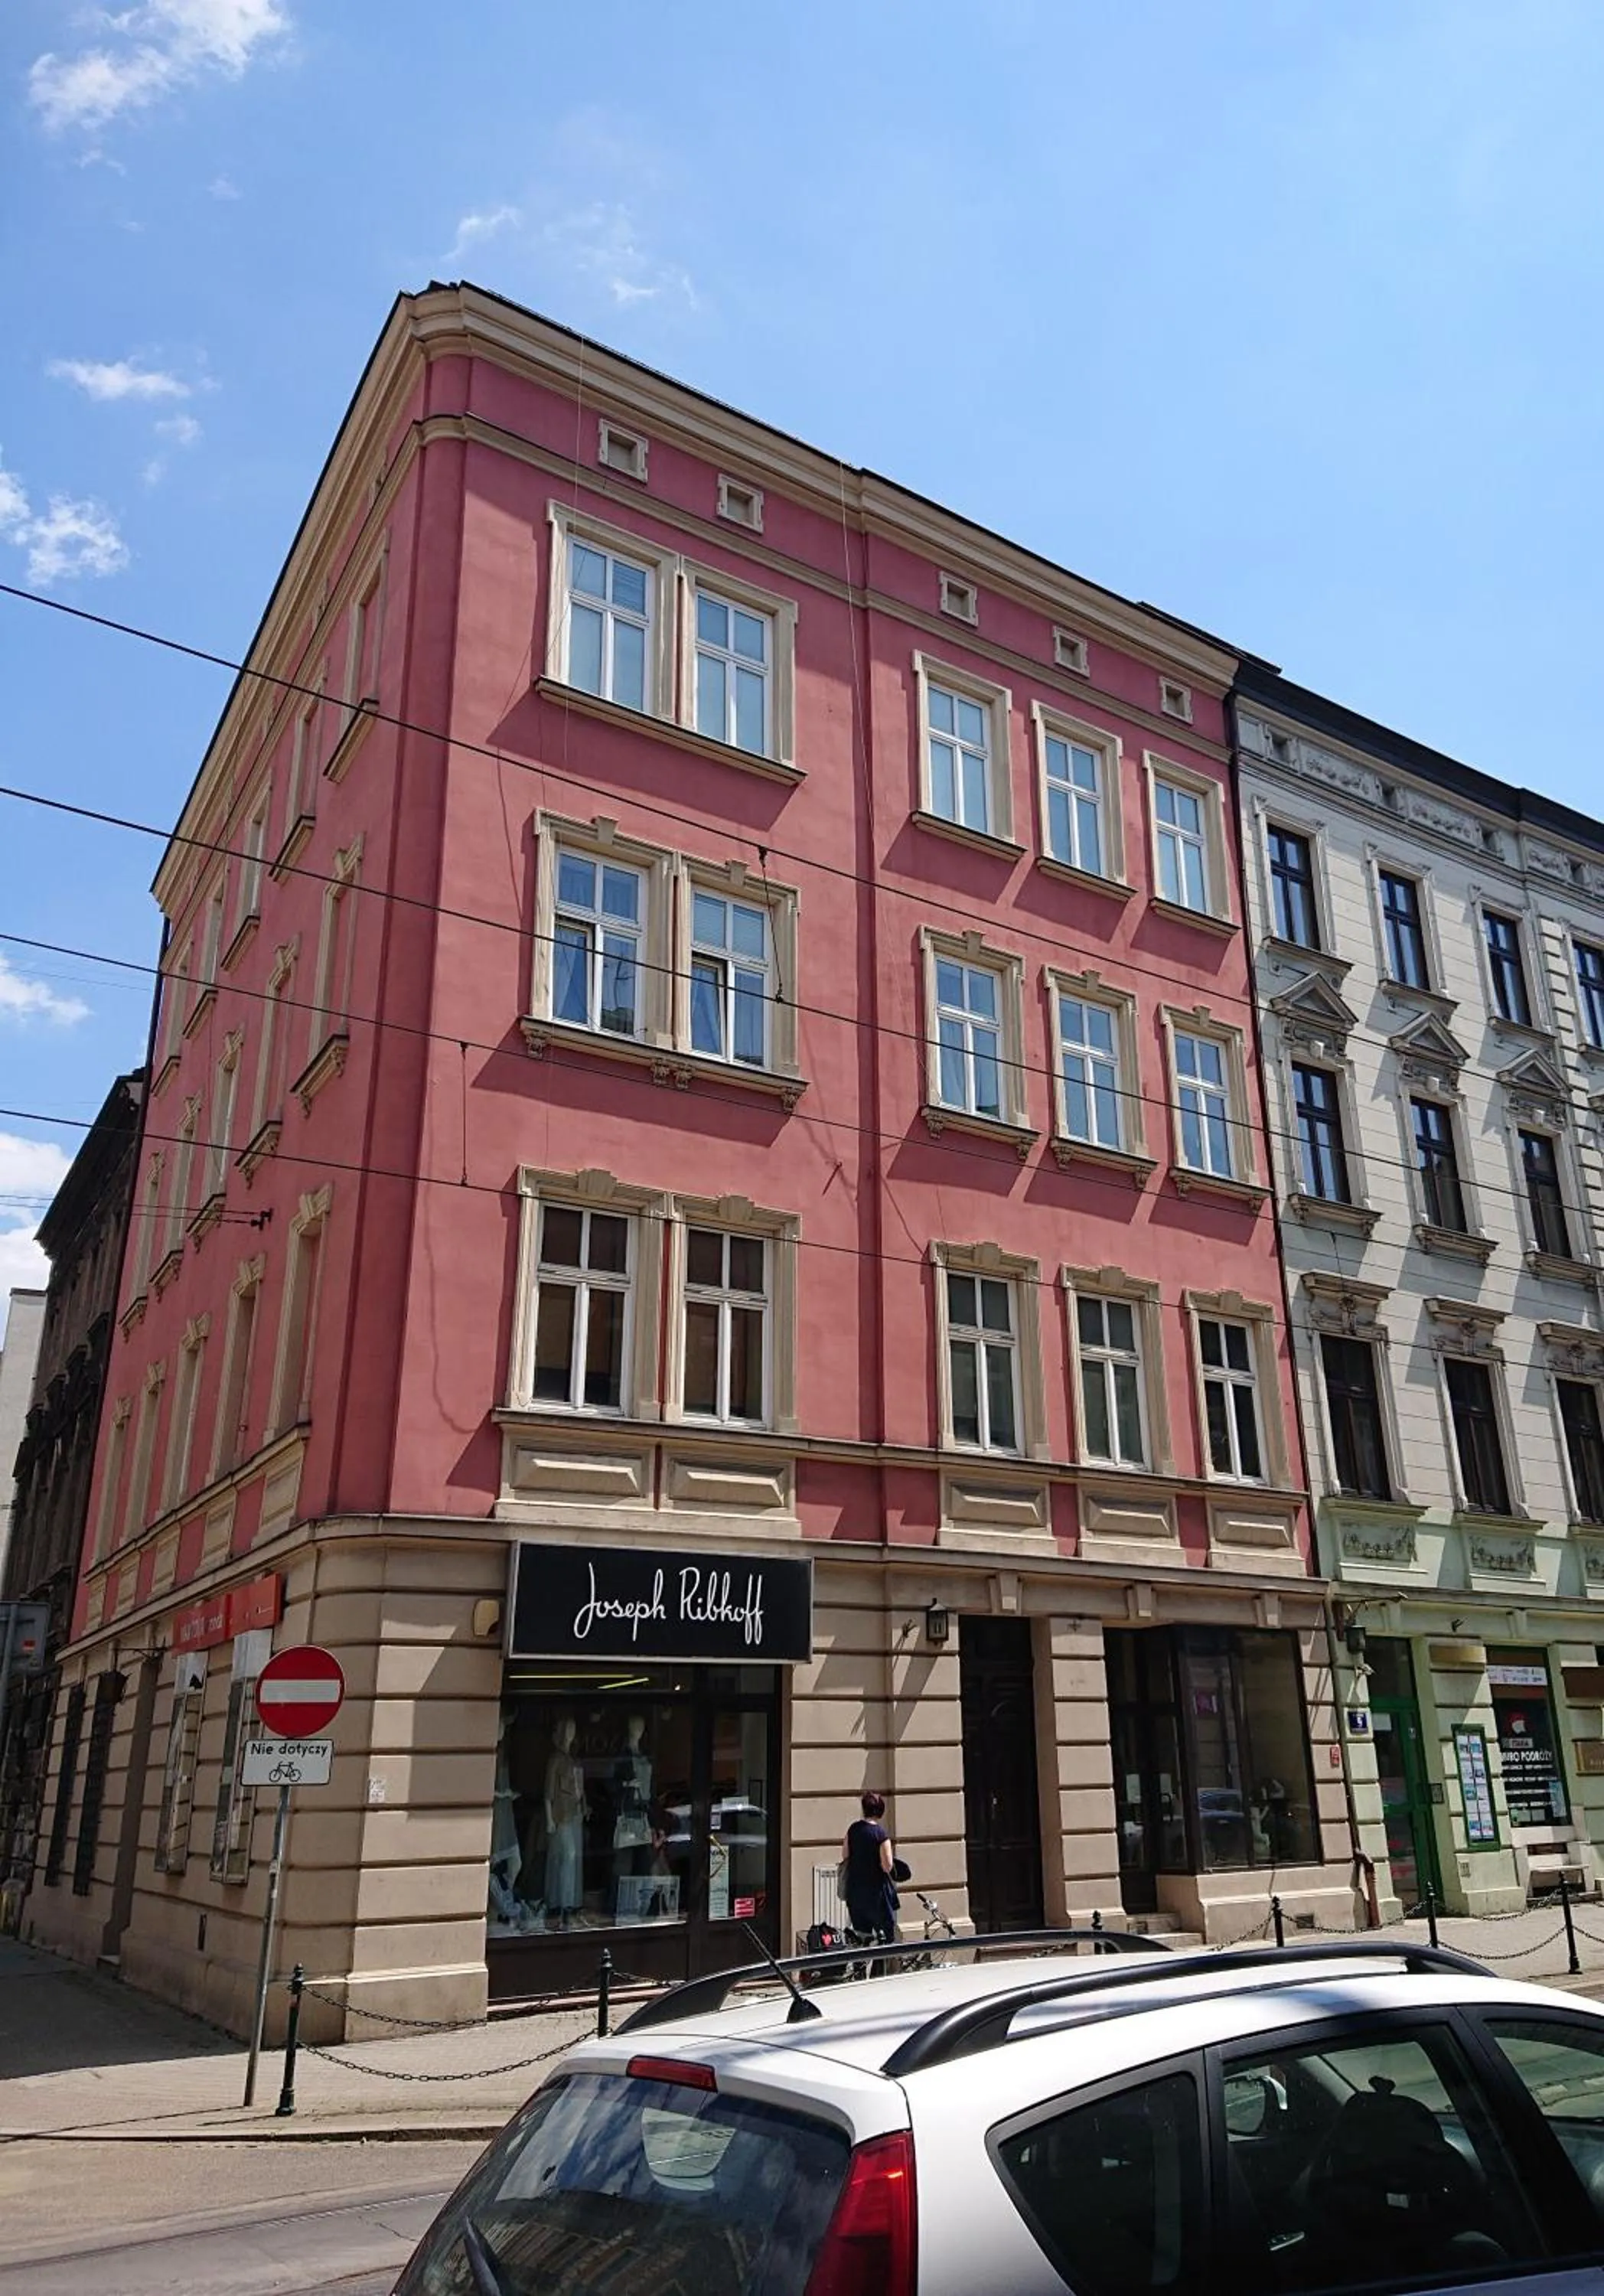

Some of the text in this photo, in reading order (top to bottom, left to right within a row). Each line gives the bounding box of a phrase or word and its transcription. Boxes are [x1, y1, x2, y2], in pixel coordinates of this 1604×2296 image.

[573, 1561, 764, 1645] Joseph Ribkoff
[250, 1743, 328, 1758] Nie dotyczy
